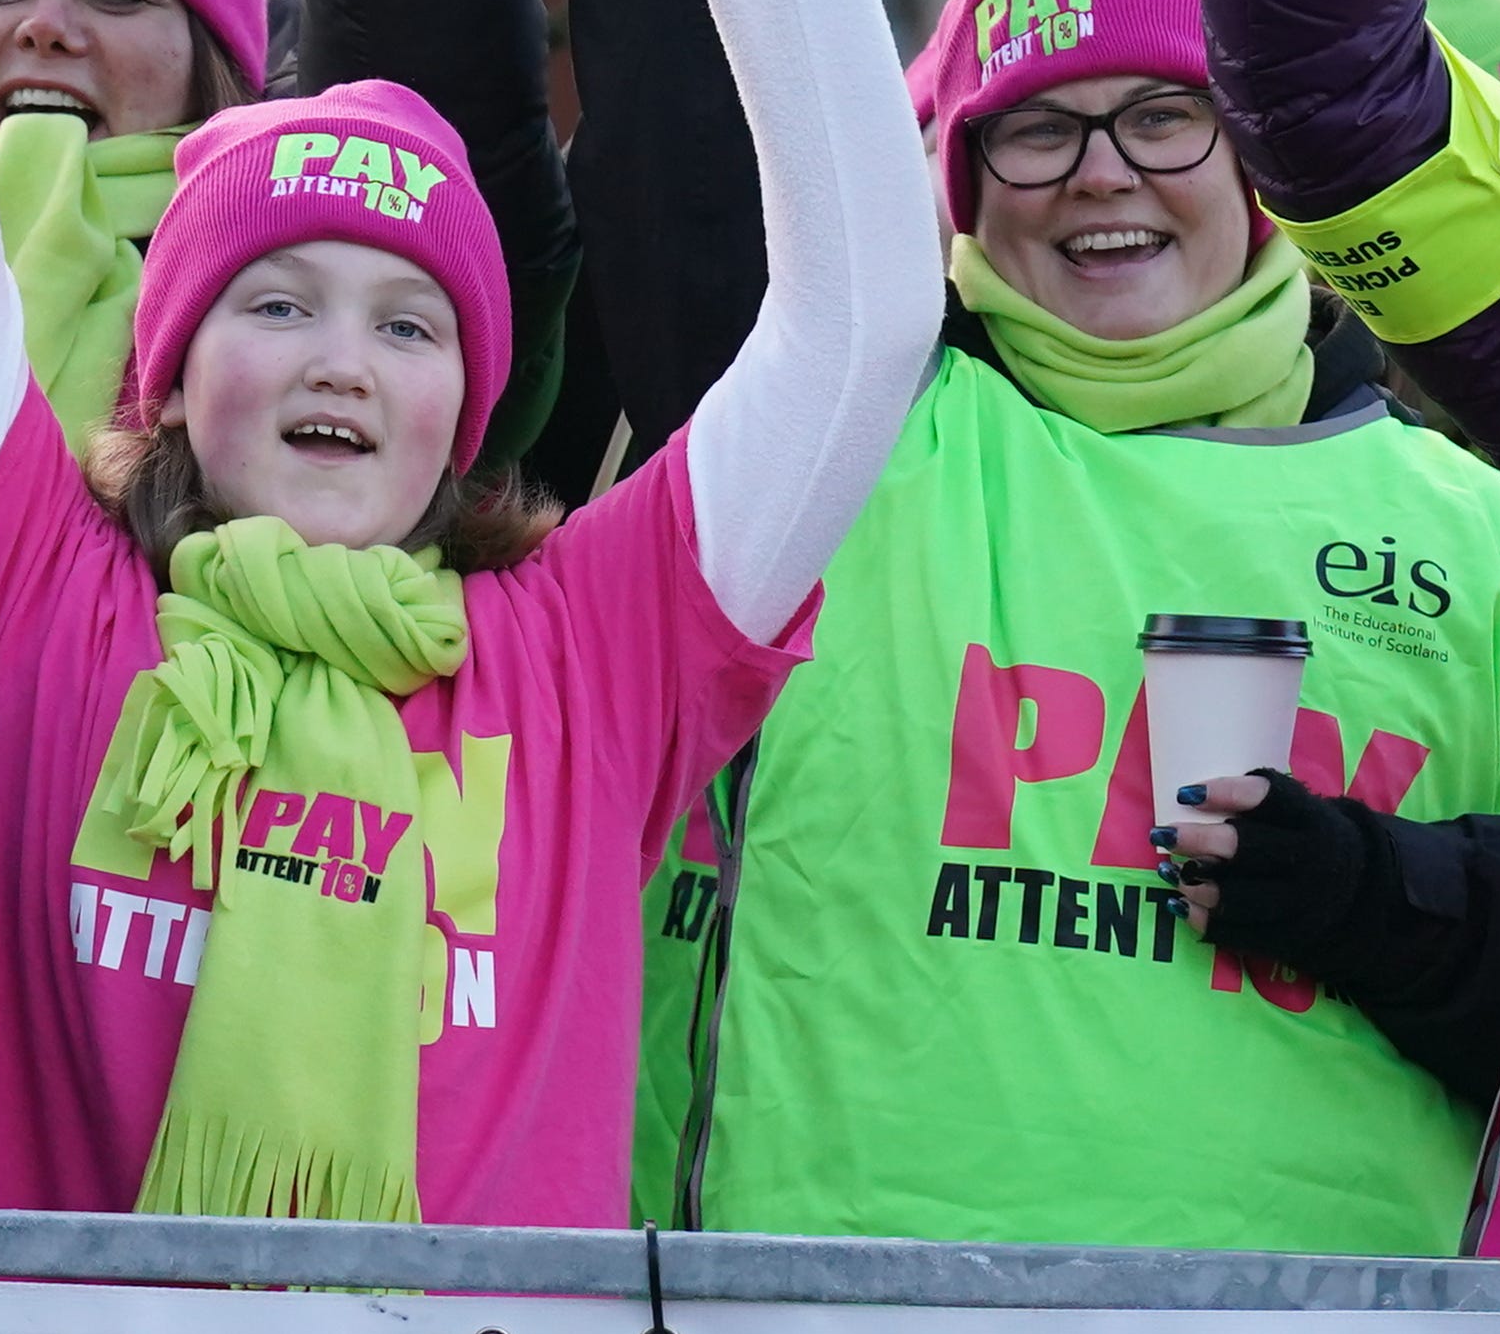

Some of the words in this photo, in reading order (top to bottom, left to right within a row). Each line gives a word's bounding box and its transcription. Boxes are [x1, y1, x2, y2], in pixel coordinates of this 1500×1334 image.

[270, 133, 448, 204] PAY
[1297, 231, 1402, 267] SUPER
[1326, 256, 1421, 292] PICKE
[1341, 293, 1384, 317] EI
[1315, 536, 1451, 619] eis
[1313, 617, 1364, 644] Institute
[1368, 636, 1383, 648] of
[1386, 638, 1448, 663] Scotland
[1323, 605, 1350, 622] The
[1353, 612, 1437, 642] Educational
[239, 788, 414, 875] PAY
[927, 862, 1353, 1014] ATTENT
